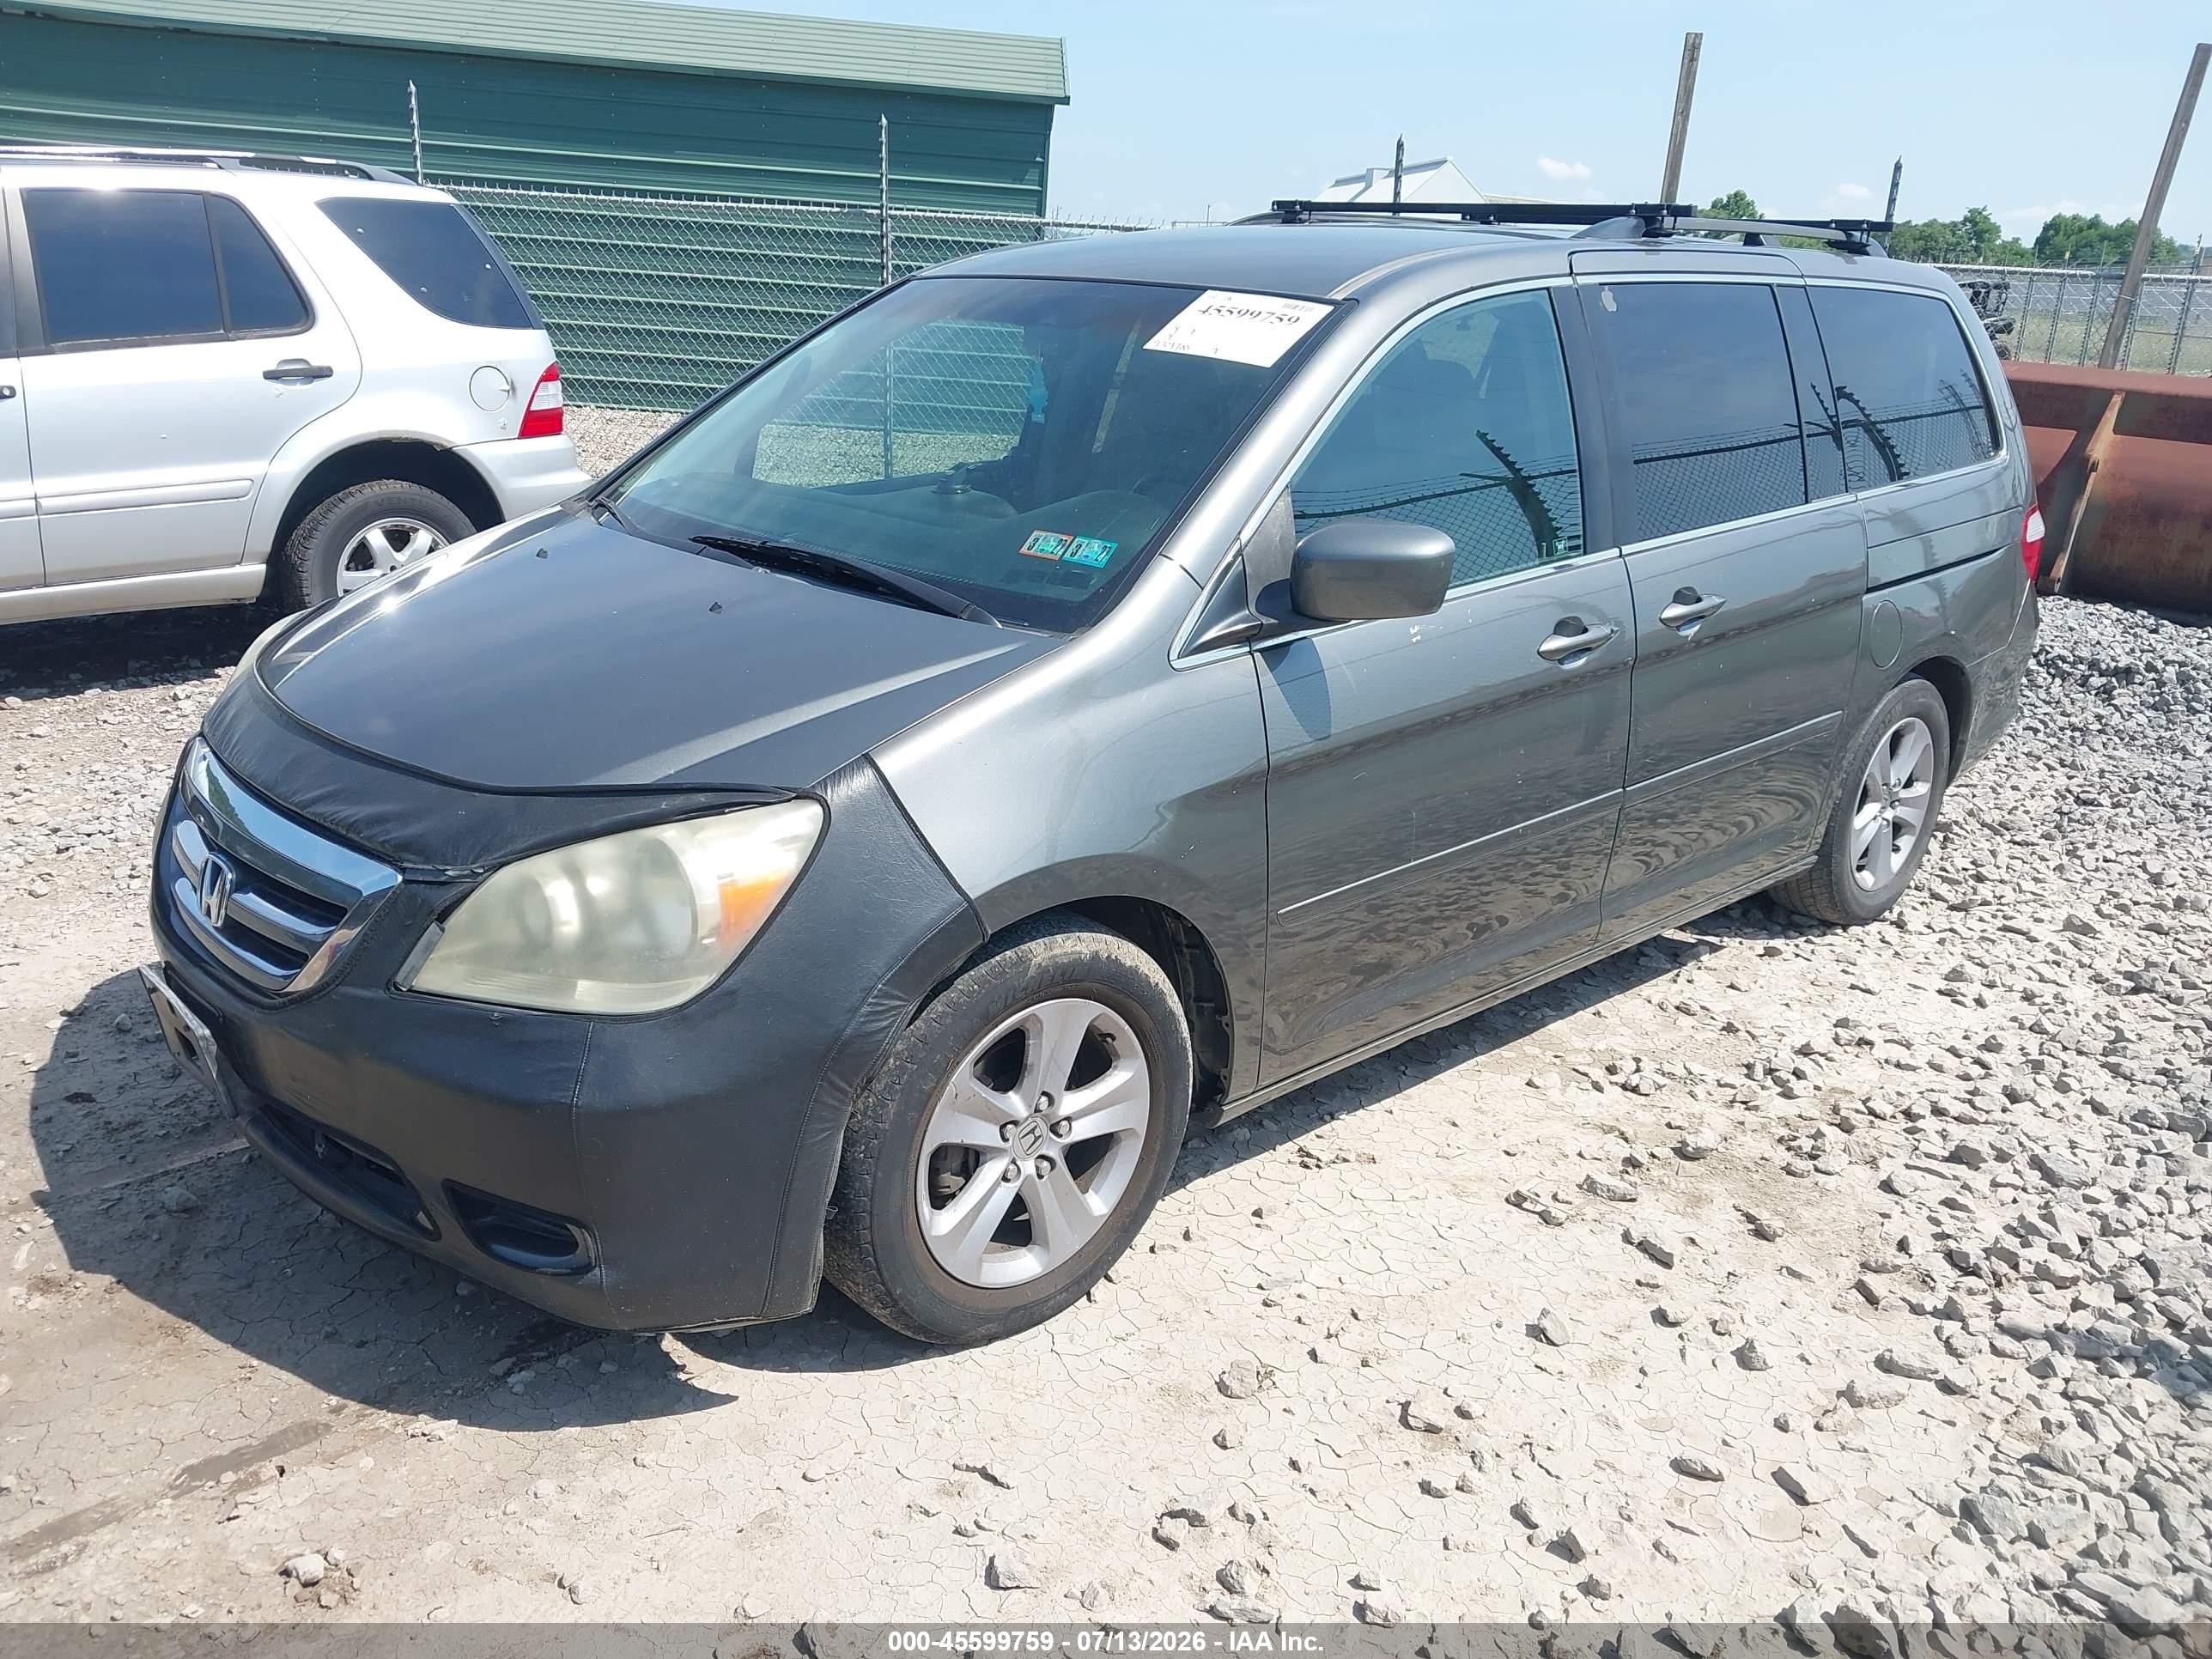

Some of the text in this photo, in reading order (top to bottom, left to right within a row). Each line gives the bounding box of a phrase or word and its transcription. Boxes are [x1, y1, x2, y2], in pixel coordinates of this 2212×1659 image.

[1198, 304, 1301, 326] 45599759
[1026, 537, 1068, 556] 3 27
[1069, 543, 1083, 558] 3
